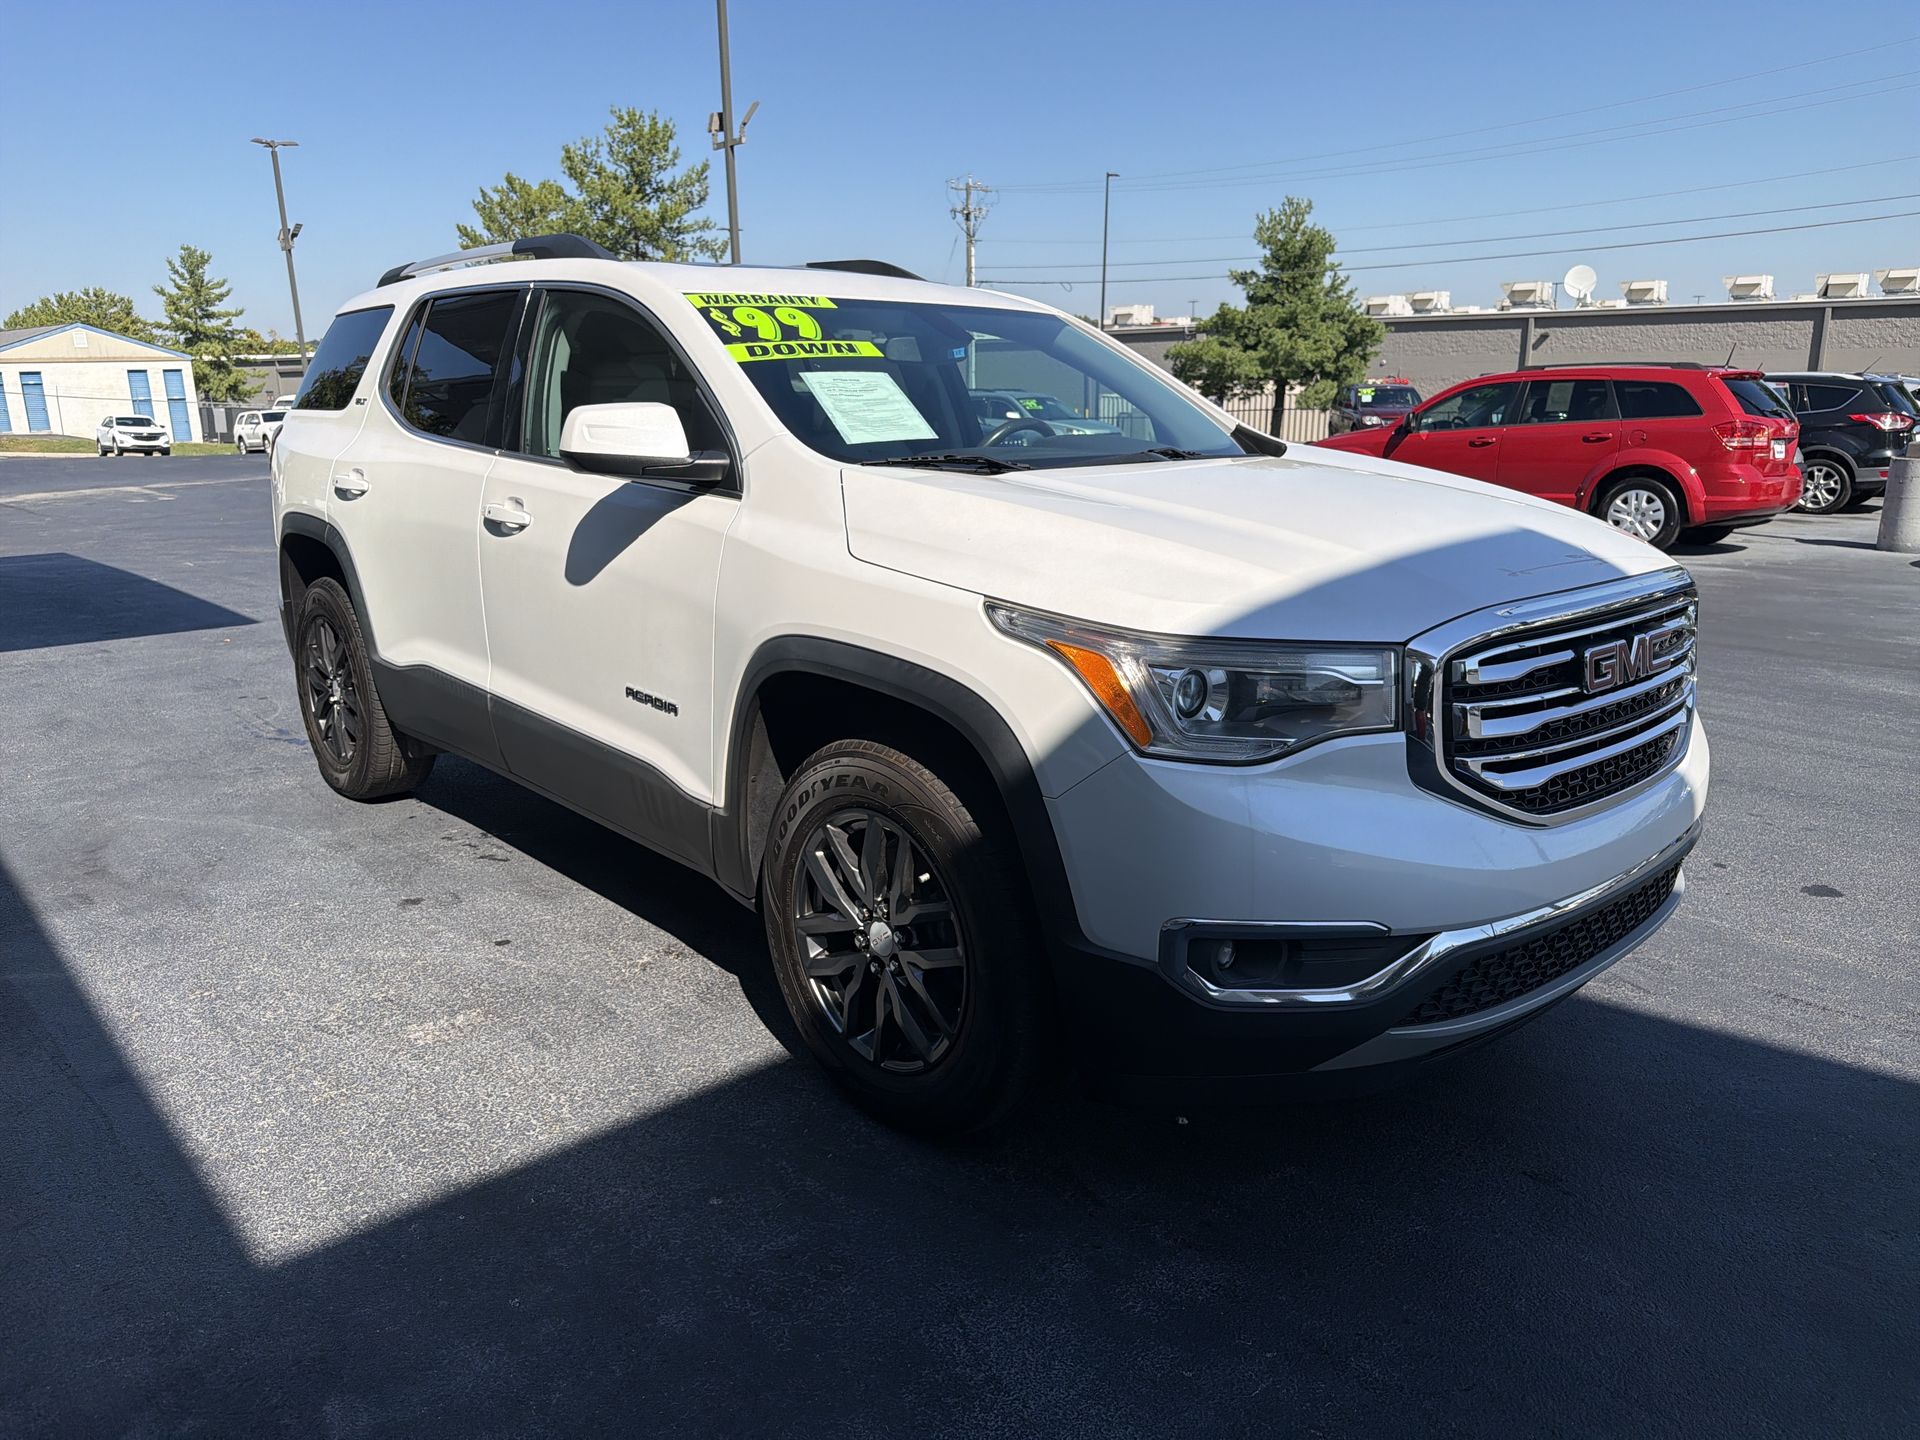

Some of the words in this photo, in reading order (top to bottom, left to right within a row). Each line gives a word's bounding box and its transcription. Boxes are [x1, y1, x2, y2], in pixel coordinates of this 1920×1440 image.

[699, 294, 822, 307] WARRANTY
[709, 306, 823, 342] $99
[745, 343, 862, 358] DOWN
[1584, 630, 1672, 695] GMC
[625, 686, 679, 718] ACADIA
